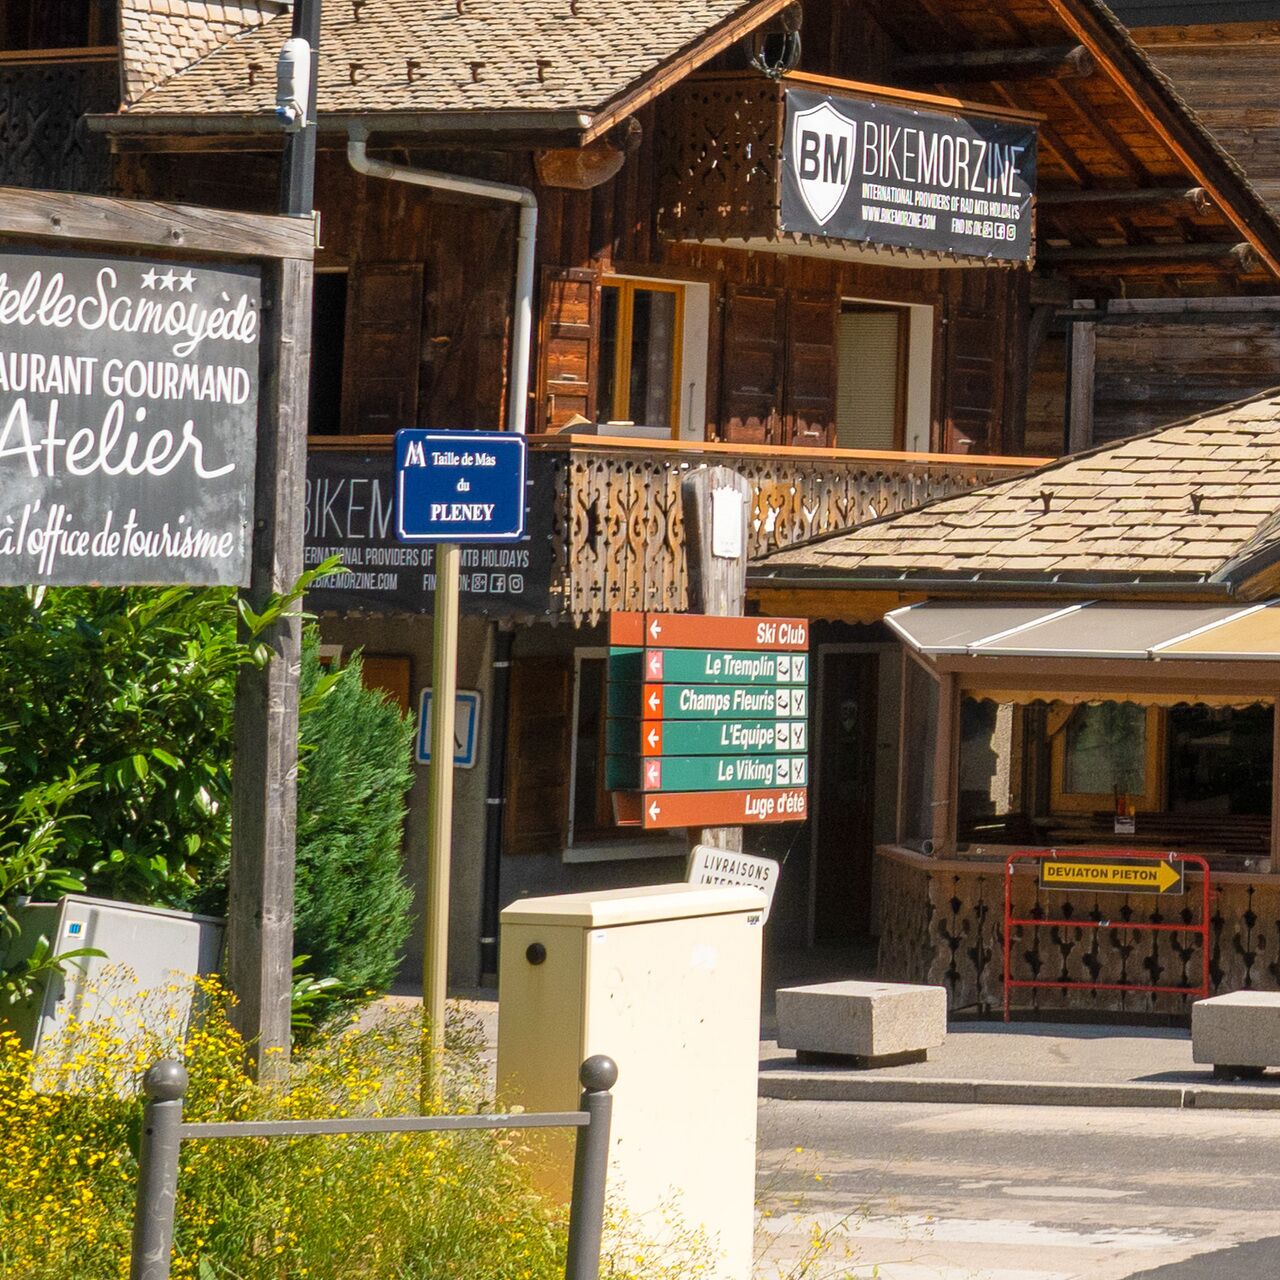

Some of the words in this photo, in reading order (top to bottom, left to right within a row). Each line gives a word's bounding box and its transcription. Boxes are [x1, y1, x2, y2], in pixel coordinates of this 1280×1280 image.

[800, 129, 848, 185] BM
[862, 121, 1024, 198] BIKEMORZINE
[861, 183, 914, 206] INTERNATIONAL
[914, 190, 951, 211] PROVIDERS
[960, 197, 974, 214] RAD
[974, 200, 989, 216] MTB
[989, 202, 1021, 220] HOLIDAYS
[861, 205, 936, 230] WWW.BIKEMORZINE.COM
[77, 267, 257, 357] Samoyède
[102, 358, 250, 404] GOURMAND
[0, 398, 235, 479] Atelier
[432, 451, 460, 466] Taille
[462, 452, 474, 466] de
[456, 477, 470, 492] du
[430, 504, 495, 521] PLENEY
[92, 510, 119, 557] de
[122, 508, 234, 558] tourisme
[365, 547, 419, 567] PROVIDERS
[421, 549, 434, 566] OF
[481, 549, 529, 568] HOLIDAYS
[756, 623, 776, 644] Ski
[778, 624, 806, 645] Club
[704, 654, 721, 674] Le
[723, 655, 775, 680] Tremplin
[680, 689, 730, 715] Champs
[732, 690, 775, 712] Fleuris
[720, 724, 774, 749] L'Equipe
[718, 761, 734, 781] Le
[736, 759, 773, 784] Viking
[745, 794, 775, 819] Luge
[776, 792, 805, 812] d'été
[703, 854, 771, 882] LIVRAISONS
[1047, 866, 1109, 879] DEVIATON
[1112, 869, 1158, 881] PIETON
